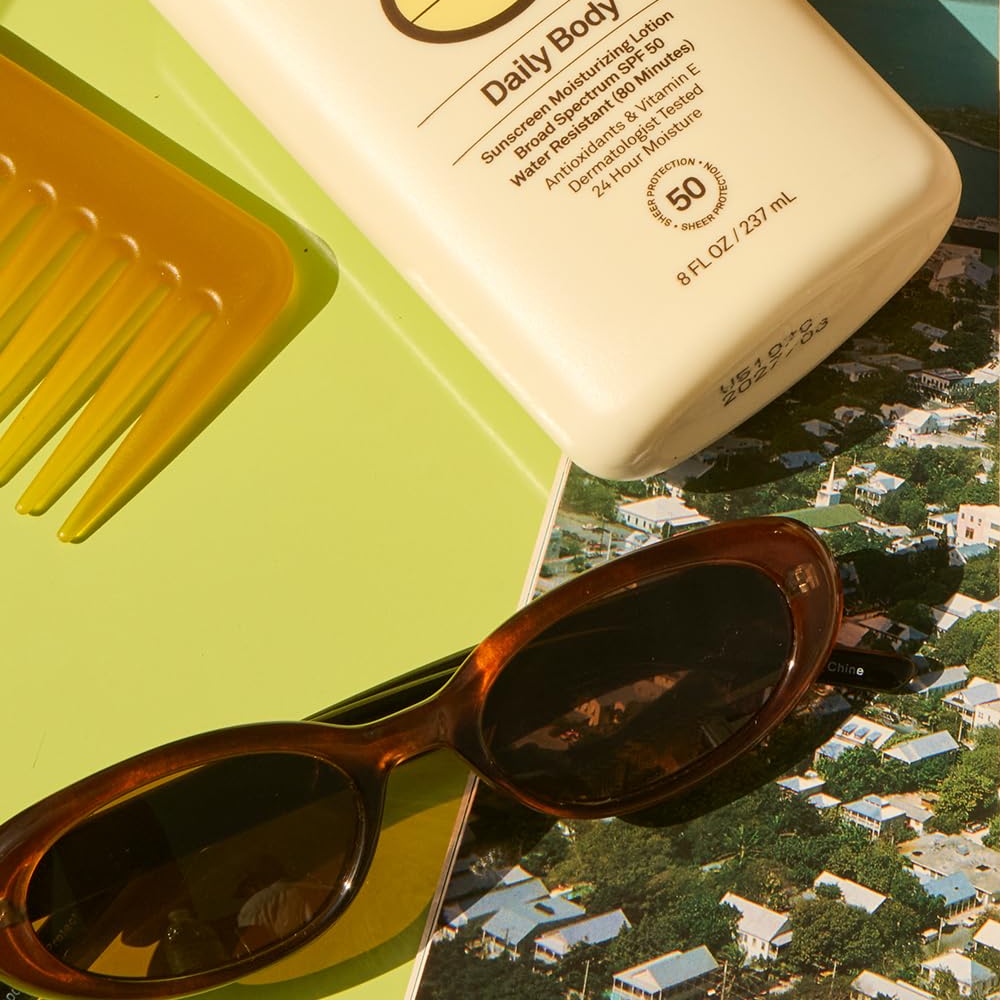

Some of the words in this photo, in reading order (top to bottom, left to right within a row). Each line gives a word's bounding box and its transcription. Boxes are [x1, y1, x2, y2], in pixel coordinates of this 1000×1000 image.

[480, 45, 552, 107] Daily
[481, 102, 551, 164] Sunscreen
[550, 40, 634, 105] Moisturizing
[629, 10, 674, 43] Lotion
[510, 152, 551, 187] Water
[550, 100, 615, 154] Resistant
[613, 81, 636, 103] (80
[633, 40, 695, 86] Minutes)
[514, 123, 556, 160] Broad
[554, 73, 620, 126] Spectrum
[618, 49, 646, 75] SPF
[645, 37, 664, 55] 50
[545, 120, 626, 191] Antioxidants
[624, 111, 639, 123] &
[635, 72, 688, 112] Vitamin
[687, 63, 700, 76] E
[568, 116, 657, 193] Dermatologist
[657, 83, 703, 120] Tested
[592, 181, 611, 198] 24
[609, 153, 644, 183] Hour
[643, 109, 703, 156] Moisture
[647, 158, 695, 197] PROTECTION
[648, 199, 672, 226] SHEER
[666, 177, 706, 211] 50
[681, 214, 715, 230] SHEER
[704, 162, 727, 215] PROTECTION
[677, 272, 690, 285] 8
[688, 258, 712, 276] FL
[708, 235, 734, 258] OZ
[740, 207, 768, 235] 237
[770, 191, 797, 212] mL
[828, 662, 864, 675] Chine
